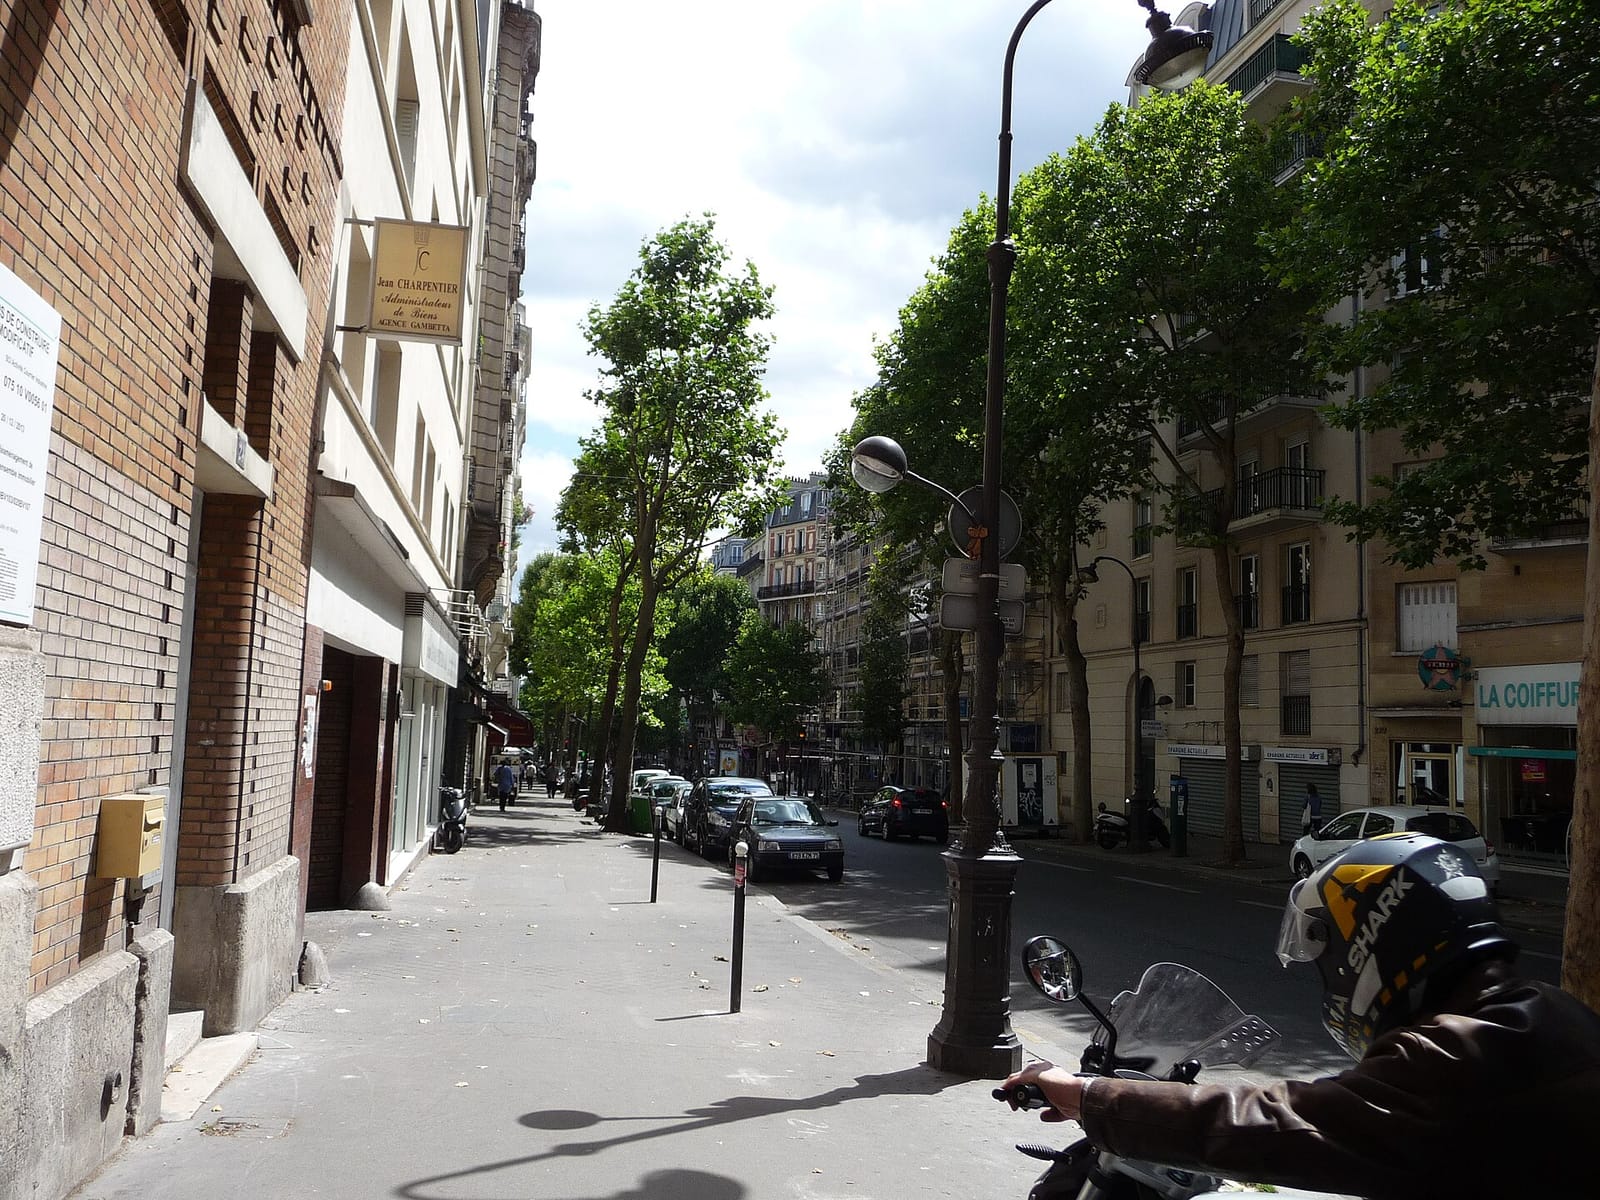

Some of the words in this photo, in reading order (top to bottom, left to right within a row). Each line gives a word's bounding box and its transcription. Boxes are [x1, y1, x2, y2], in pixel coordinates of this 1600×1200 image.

[377, 276, 394, 288] Jean
[397, 278, 458, 294] CHARPENTIER
[393, 306, 404, 317] de
[410, 309, 438, 320] Biens
[378, 319, 407, 329] AGENCE
[410, 321, 450, 332] GAMBETTA
[1479, 684, 1500, 708] LA
[1347, 866, 1415, 975] SHARK
